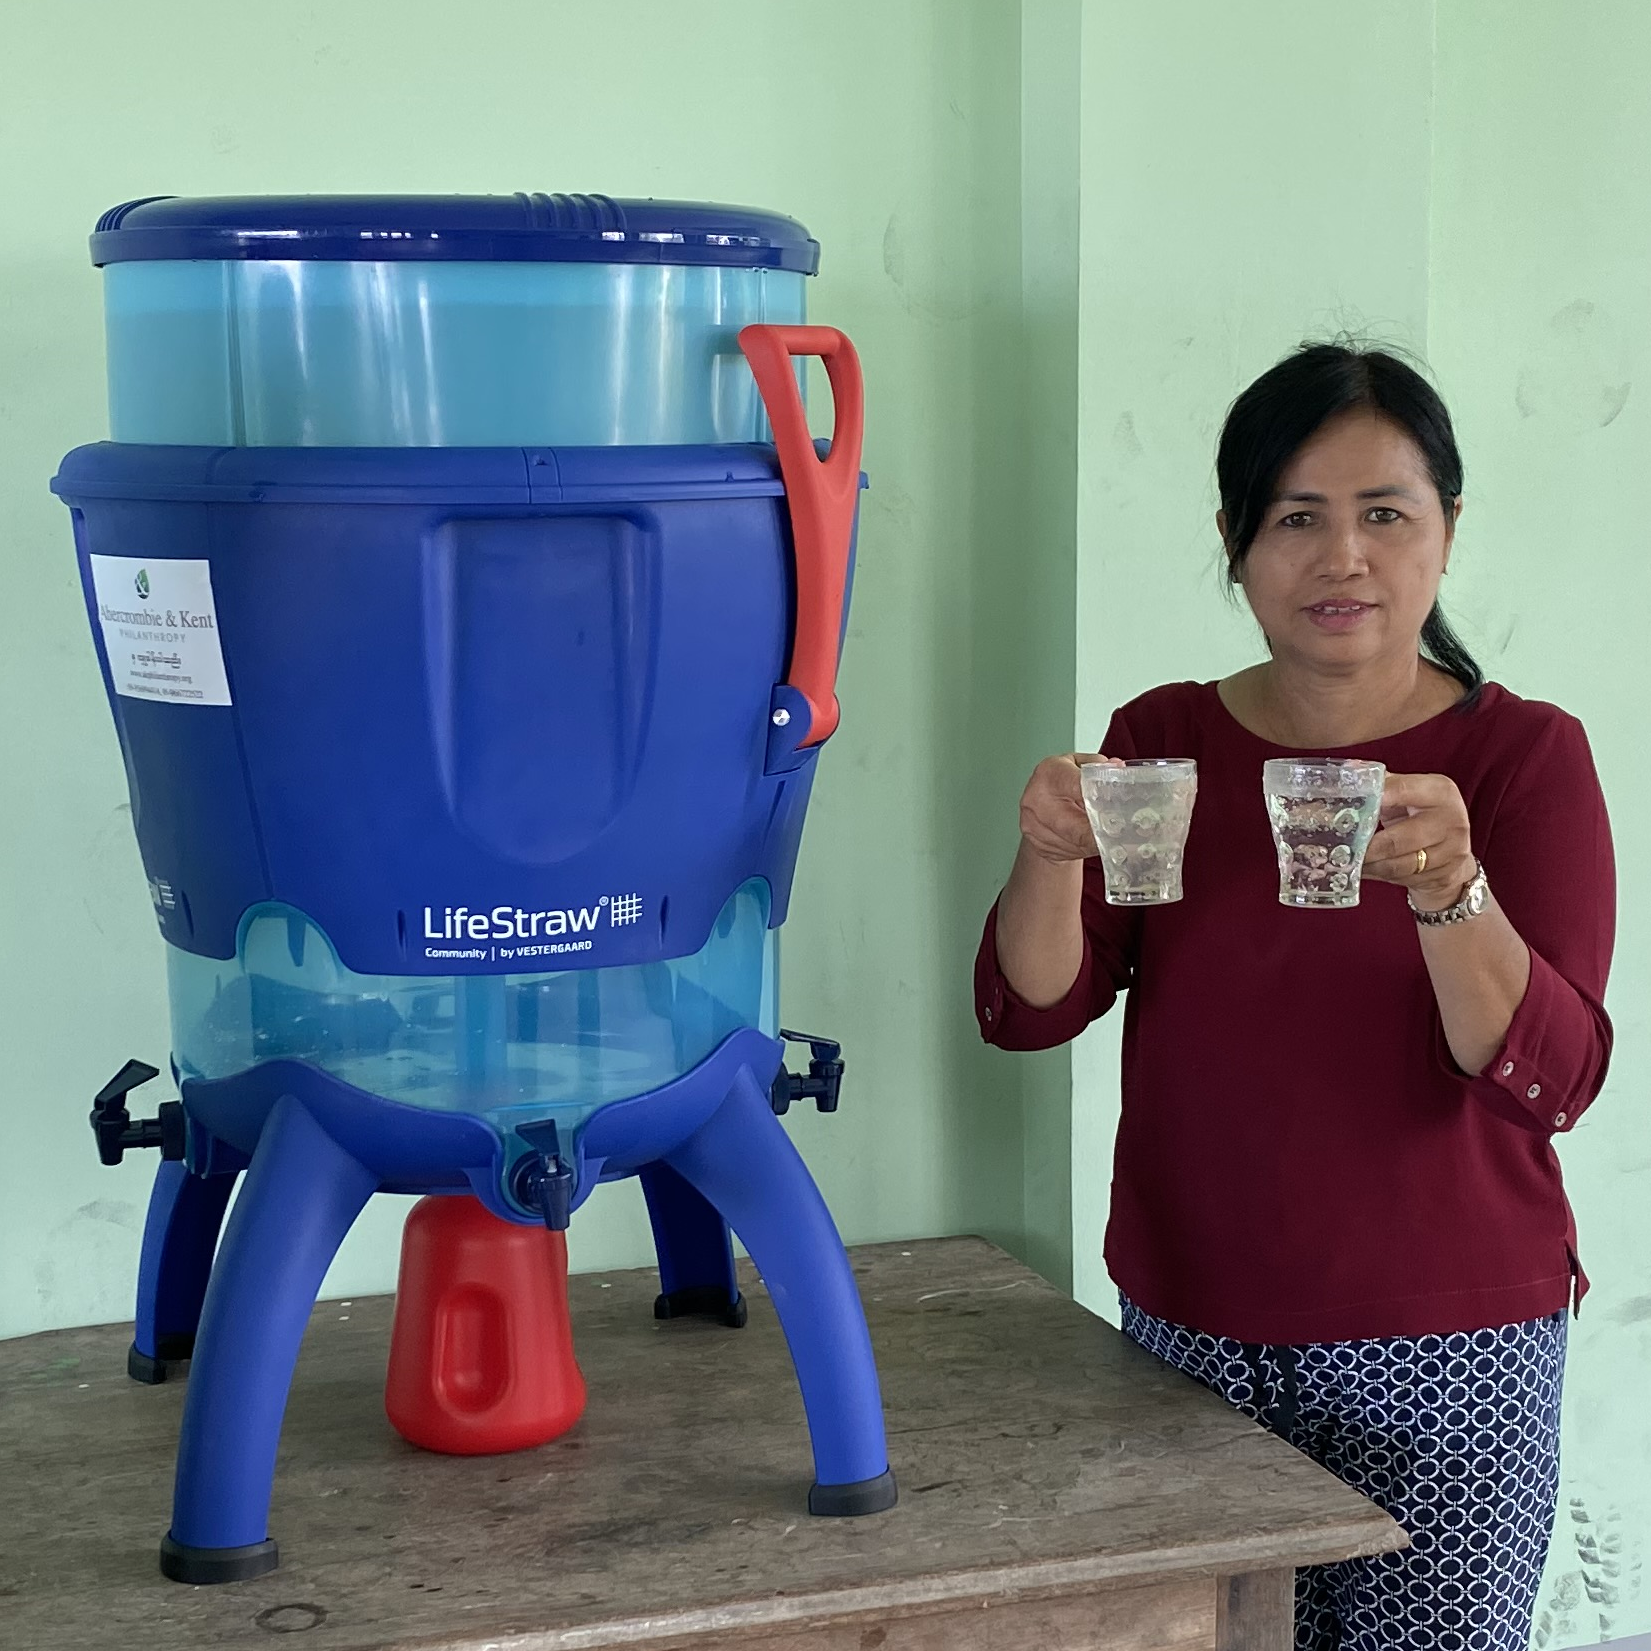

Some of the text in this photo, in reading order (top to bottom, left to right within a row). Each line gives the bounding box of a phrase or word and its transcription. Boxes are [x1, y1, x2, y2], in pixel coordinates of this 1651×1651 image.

[100, 605, 214, 629] Abercrombie & Kent
[119, 629, 186, 643] PHILANTHROPY
[425, 940, 592, 960] Community by VESTERGAARD
